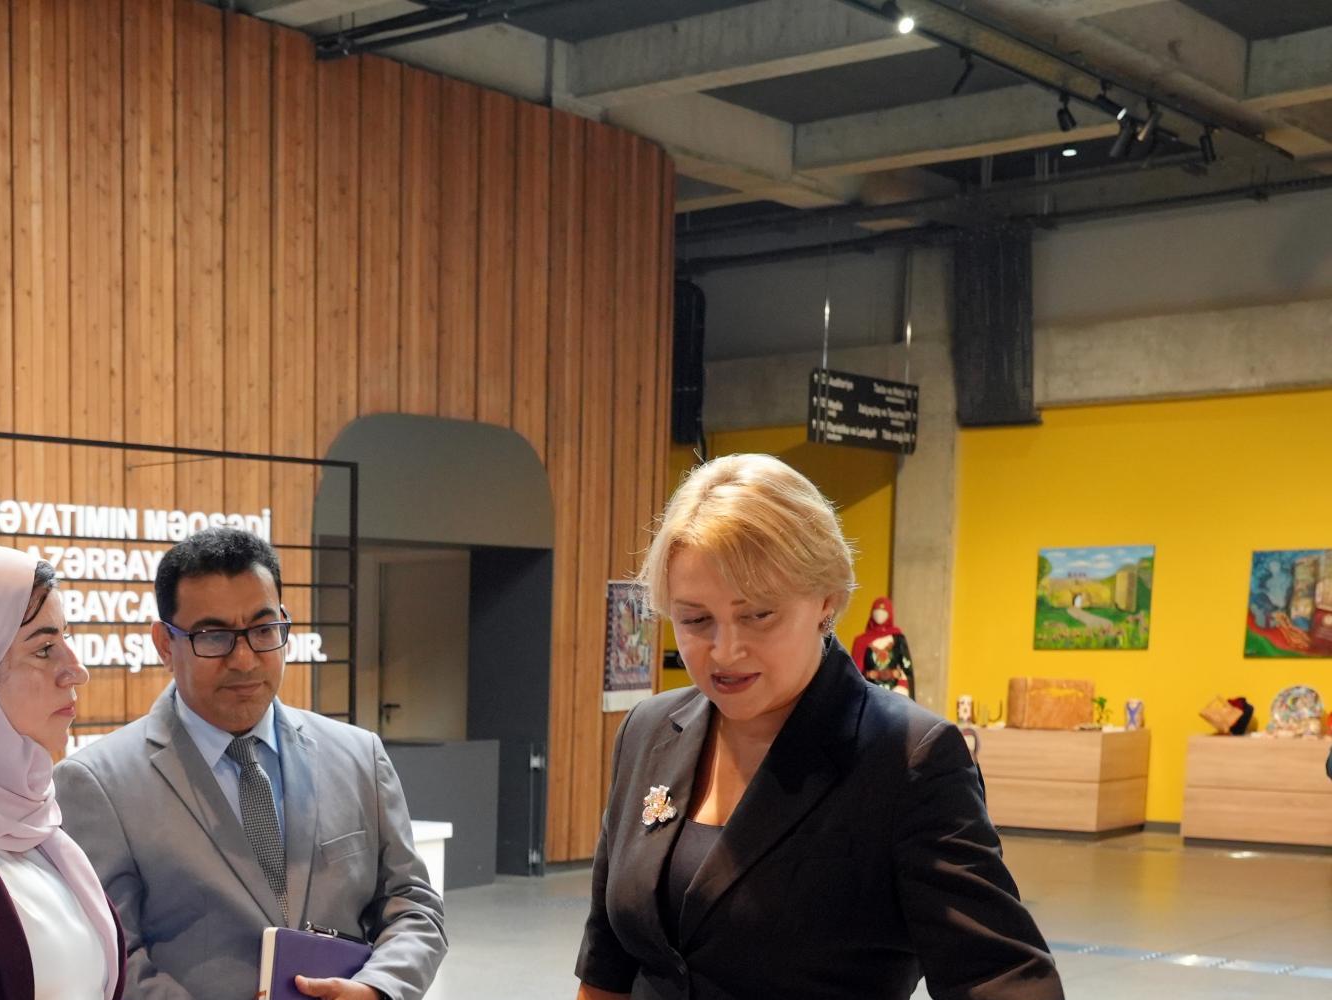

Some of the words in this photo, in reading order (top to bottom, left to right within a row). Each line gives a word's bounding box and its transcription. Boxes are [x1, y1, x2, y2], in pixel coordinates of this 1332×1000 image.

[27, 545, 166, 581] ZƏRBAY
[61, 589, 160, 623] BAYCA
[284, 632, 328, 662] DIR.
